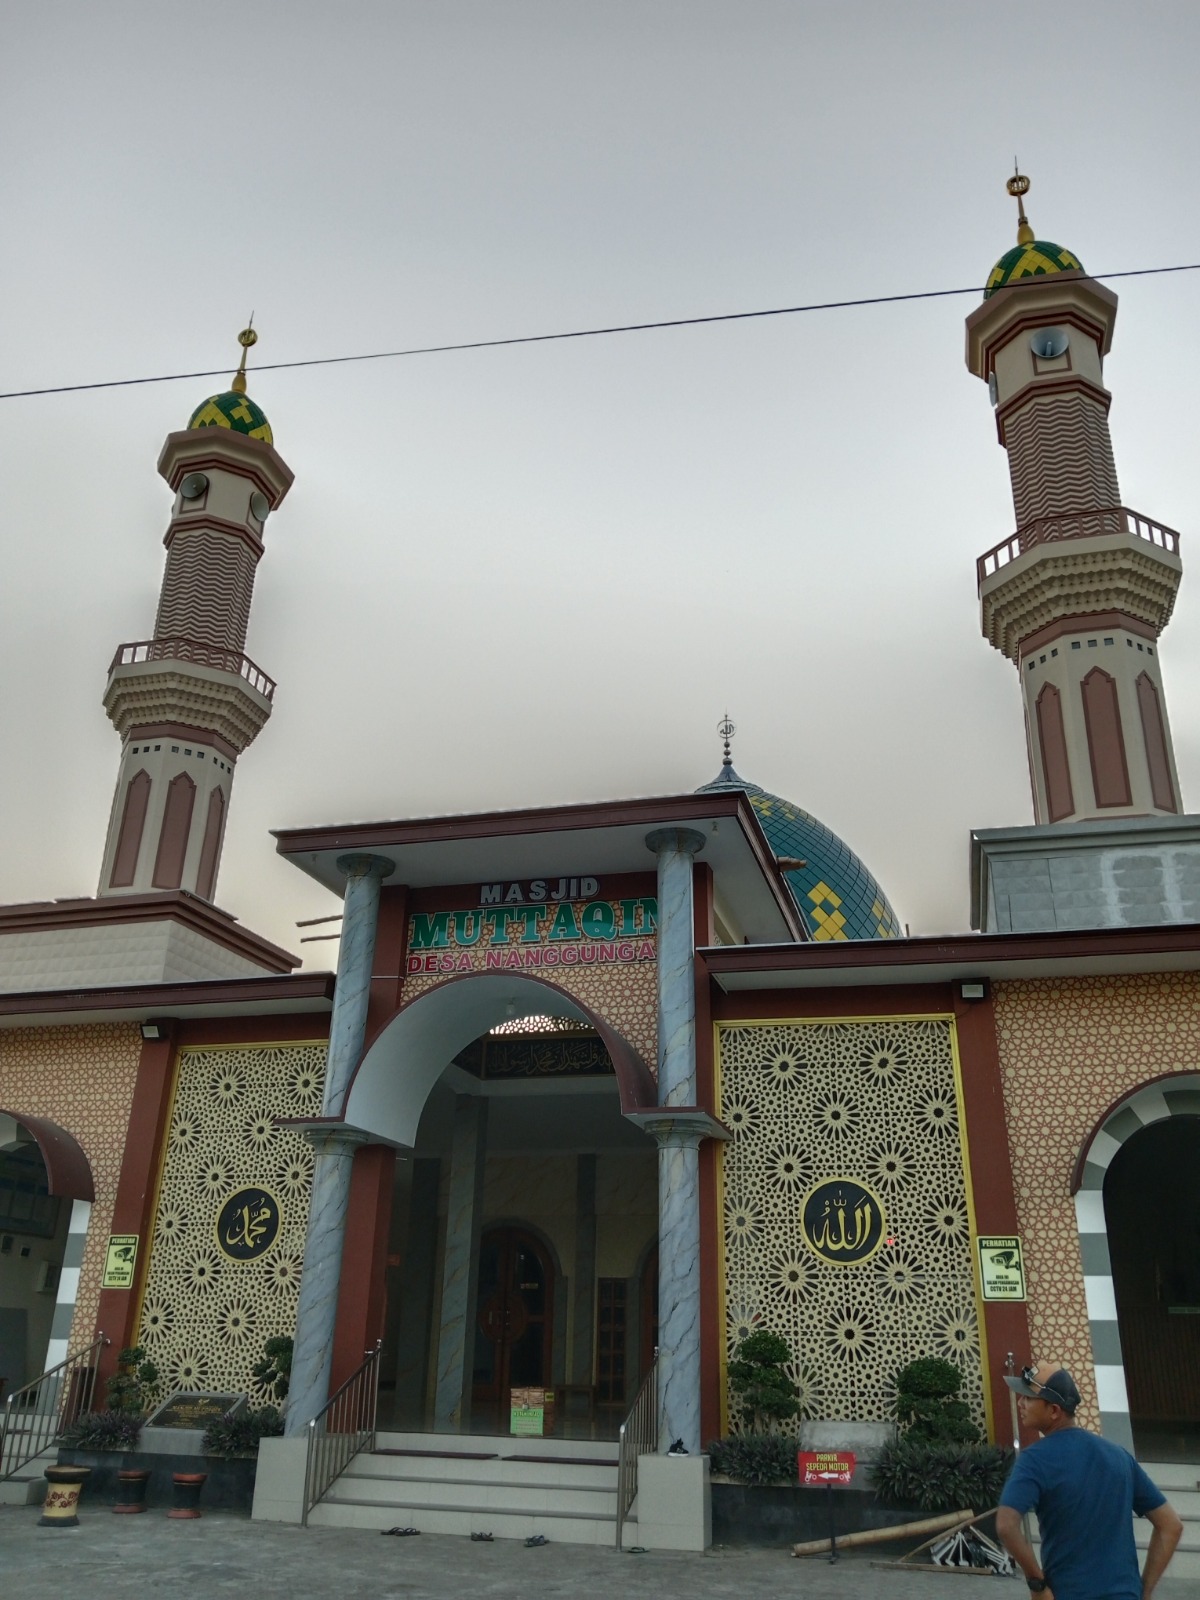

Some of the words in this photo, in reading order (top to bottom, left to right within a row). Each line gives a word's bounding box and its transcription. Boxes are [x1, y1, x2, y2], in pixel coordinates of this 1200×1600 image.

[480, 877, 599, 904] MASJID
[407, 953, 473, 973] DESA
[816, 1453, 838, 1462] PARKIR
[805, 1462, 828, 1471] SEPEDA
[829, 1462, 849, 1471] MOTOR
